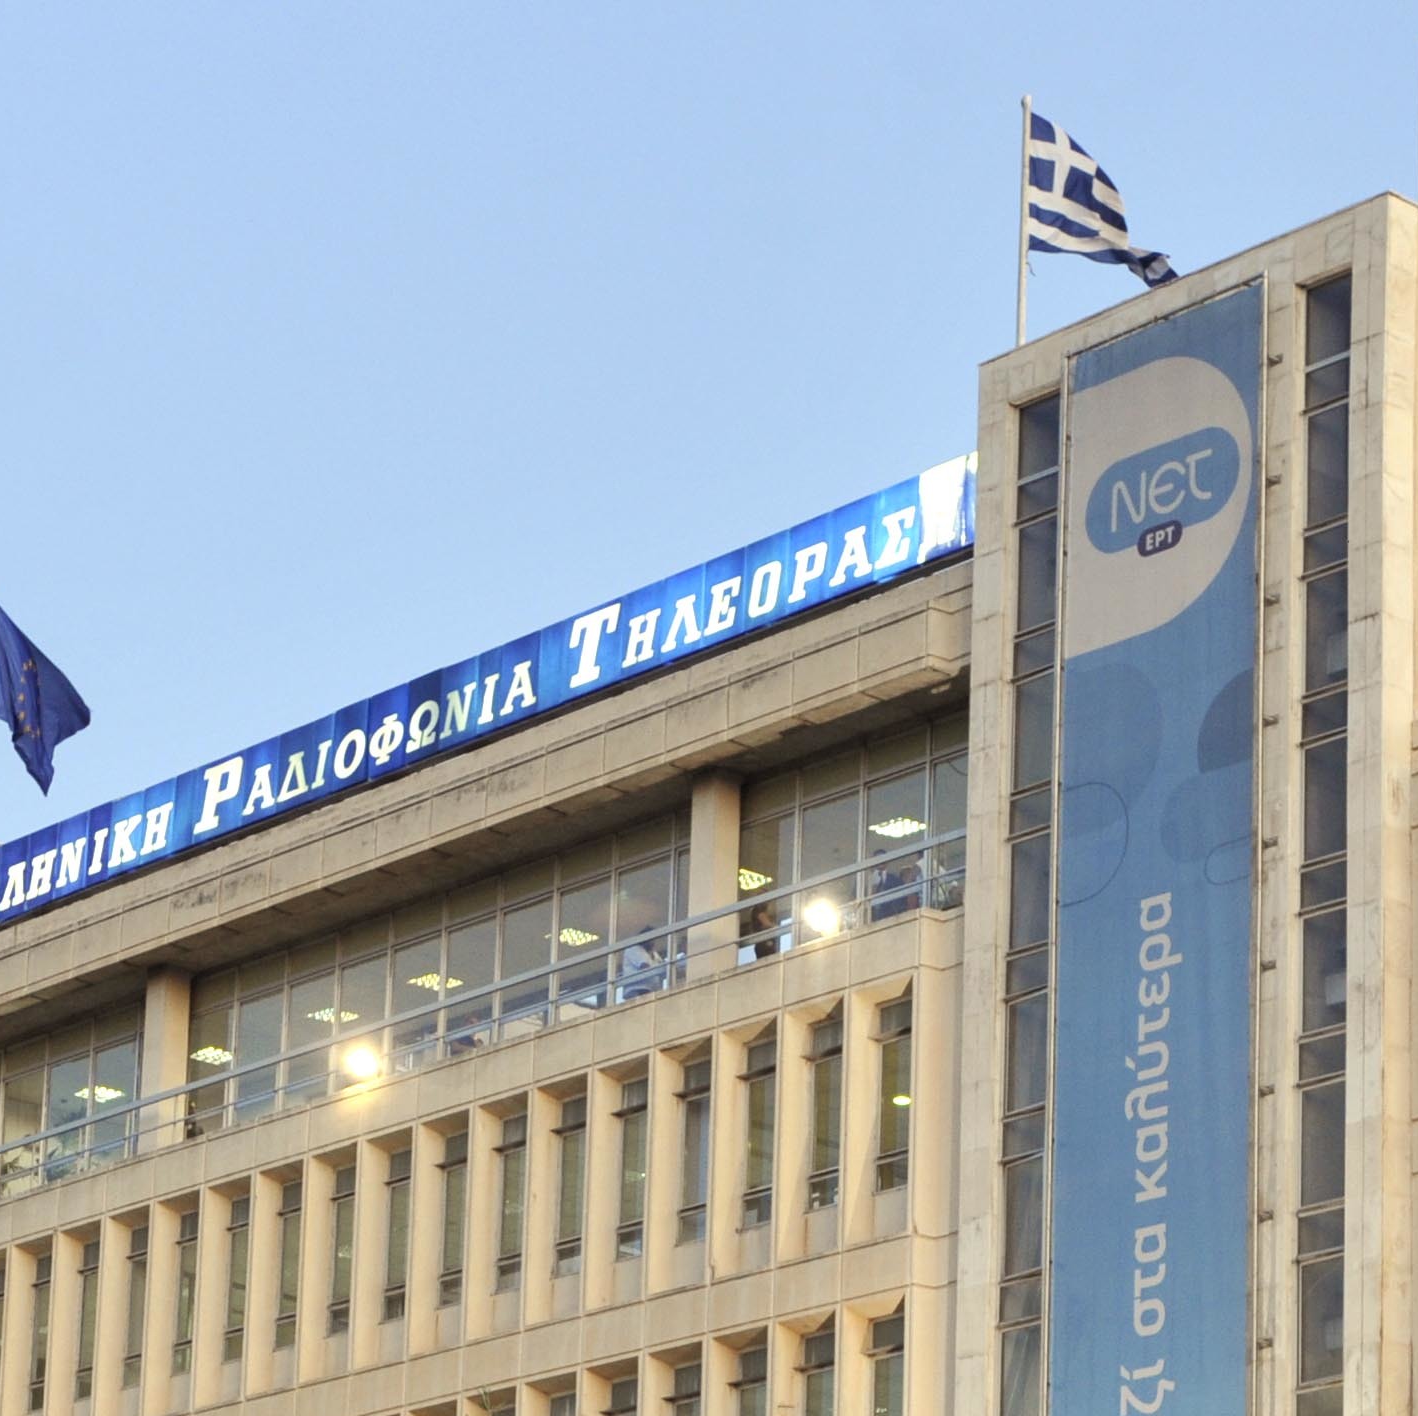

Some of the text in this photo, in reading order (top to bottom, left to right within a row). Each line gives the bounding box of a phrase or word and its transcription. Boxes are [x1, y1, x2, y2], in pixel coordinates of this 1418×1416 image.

[193, 660, 537, 836] ΡΑΔΙΟΦΩΝΙΑ
[568, 490, 954, 689] ΤΗΛΕΟΡΑΣ
[1123, 891, 1183, 1204] καλύτερα
[1131, 1222, 1168, 1338] στα
